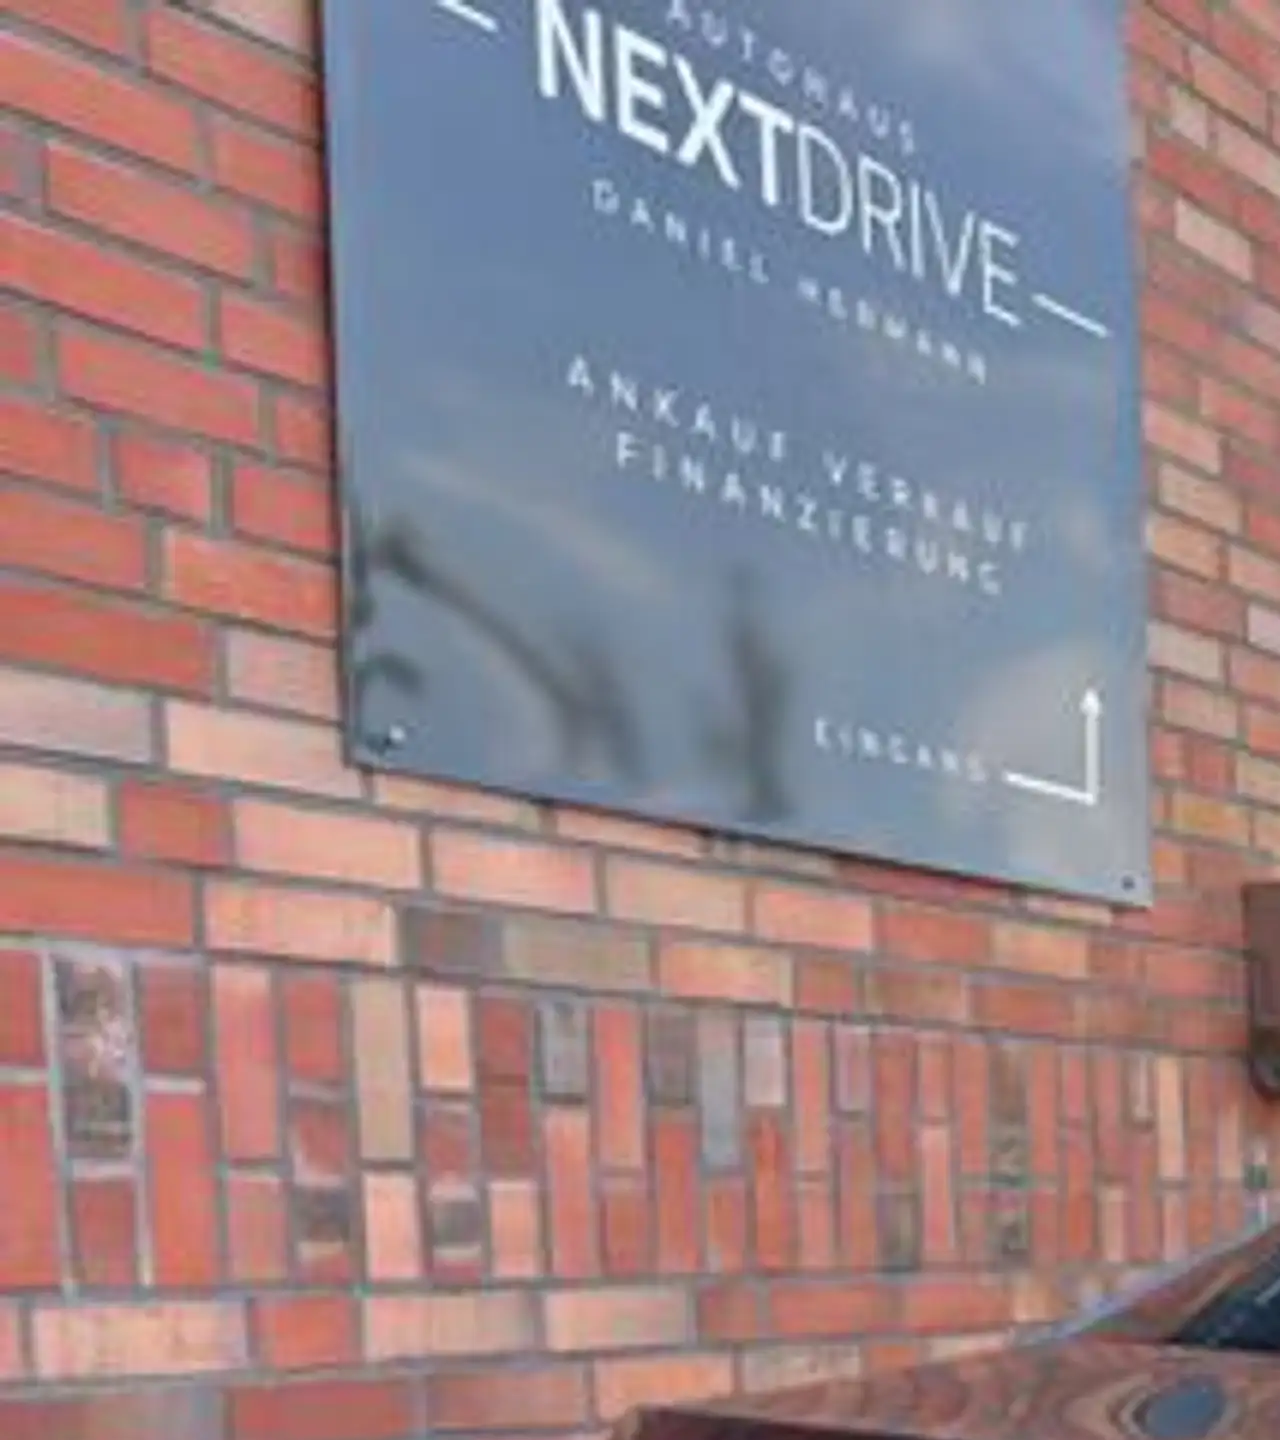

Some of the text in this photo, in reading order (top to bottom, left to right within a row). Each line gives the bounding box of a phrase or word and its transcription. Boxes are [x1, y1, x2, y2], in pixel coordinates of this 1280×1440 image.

[664, 0, 917, 156] AUTOHAUS
[534, 0, 1022, 328] NEXTDRIVE
[592, 178, 771, 285] DANIEL
[567, 354, 1029, 552] ANKAUF VERKAUF
[615, 431, 1001, 596] FINANZIERUNG
